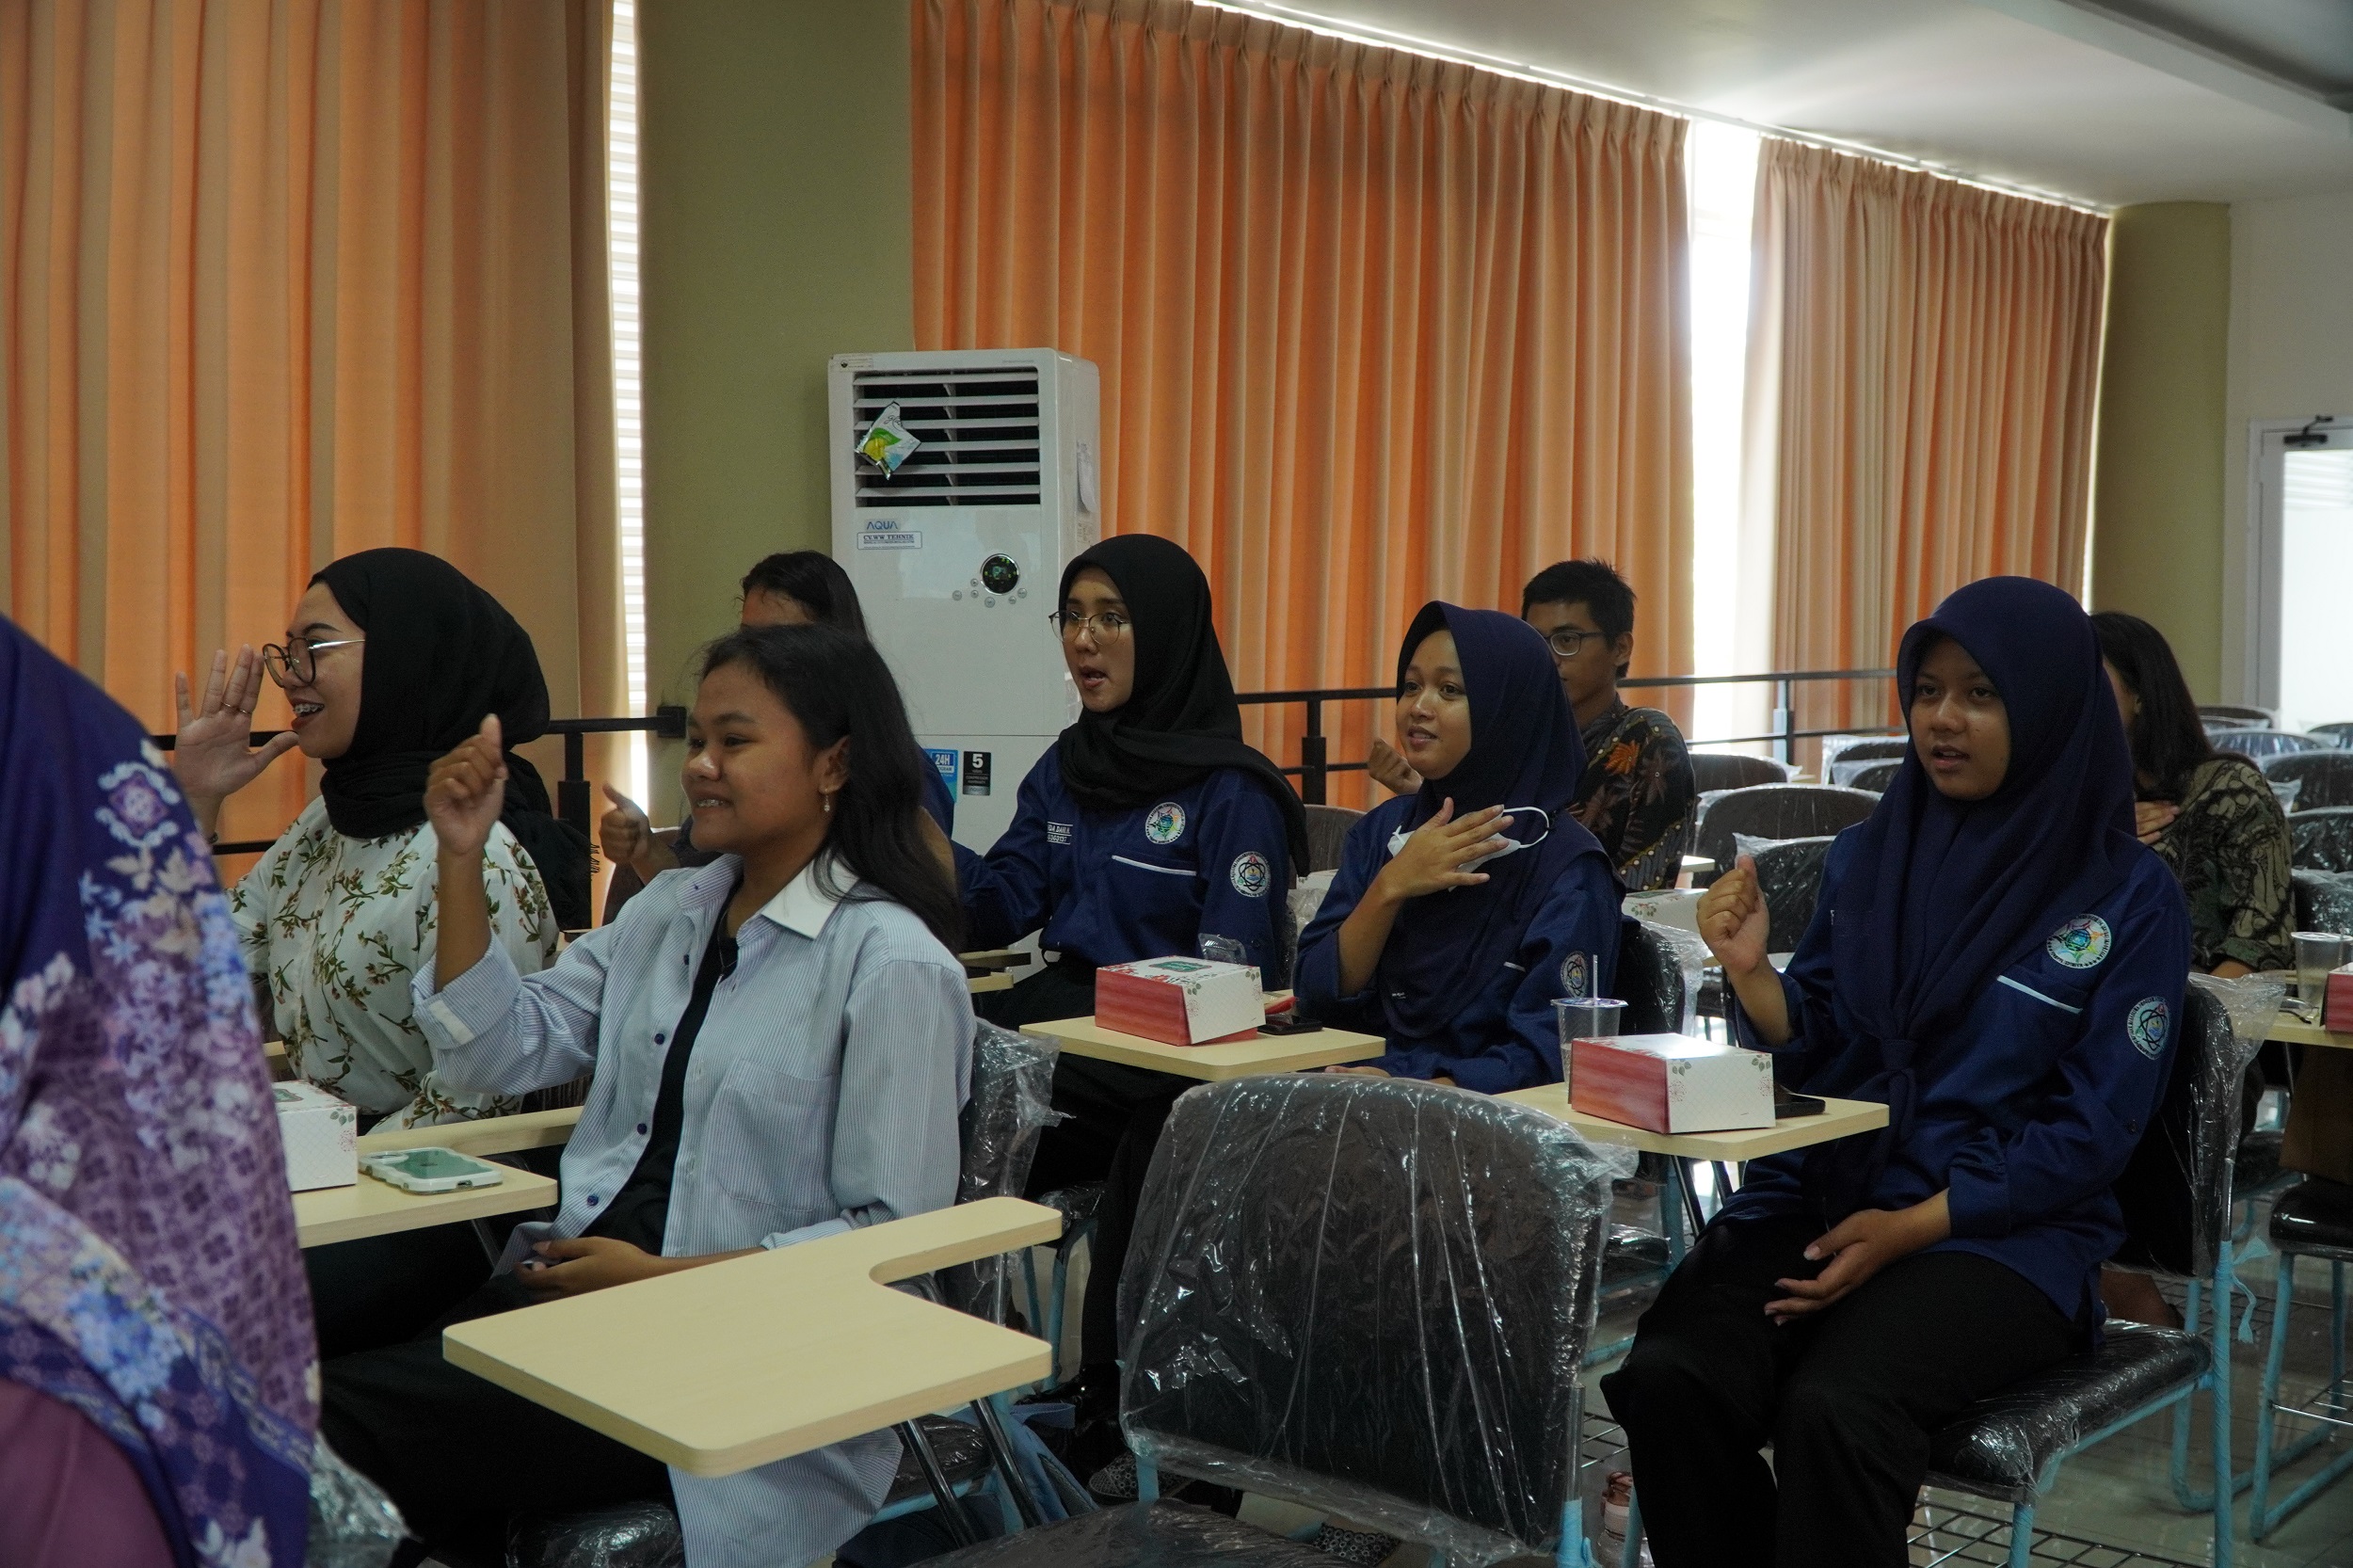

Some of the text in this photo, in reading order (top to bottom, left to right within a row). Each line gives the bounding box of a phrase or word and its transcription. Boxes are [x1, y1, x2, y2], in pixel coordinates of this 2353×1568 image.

[867, 520, 898, 530] AQUA
[935, 754, 951, 765] 24H
[971, 753, 984, 769] 5
